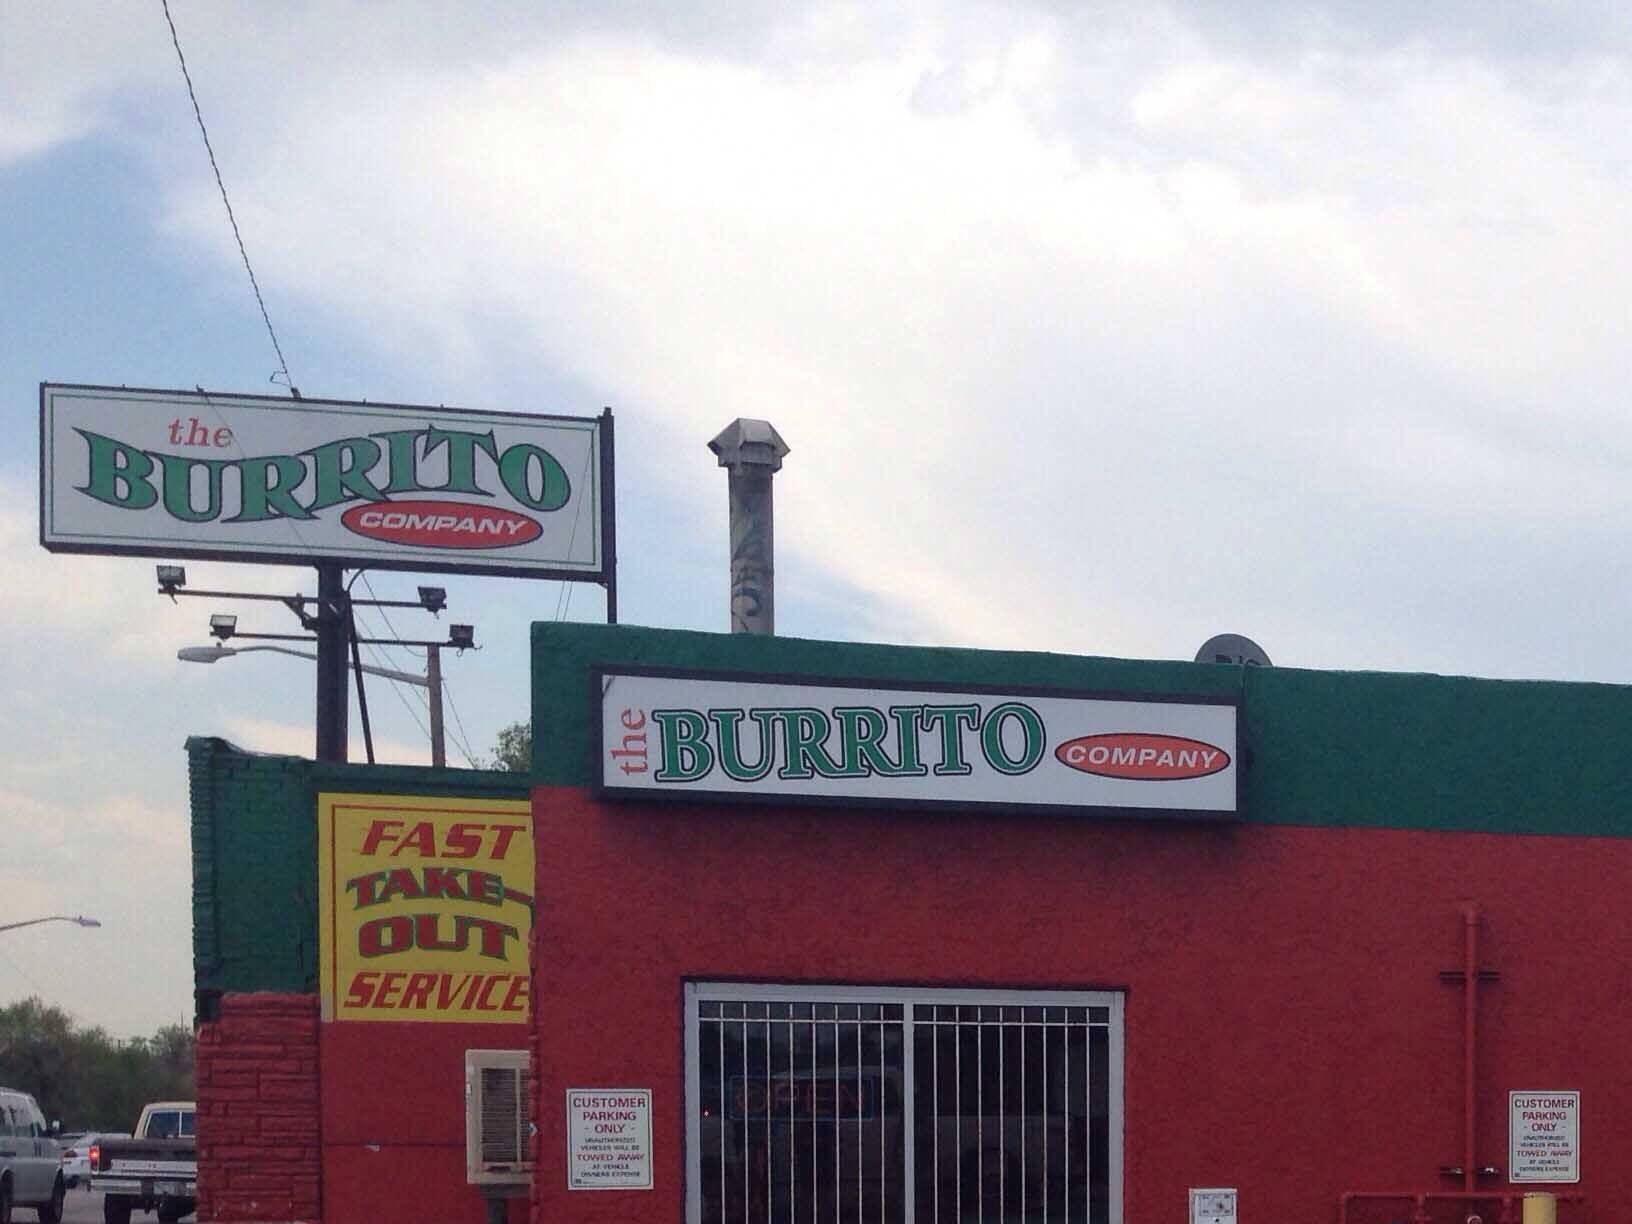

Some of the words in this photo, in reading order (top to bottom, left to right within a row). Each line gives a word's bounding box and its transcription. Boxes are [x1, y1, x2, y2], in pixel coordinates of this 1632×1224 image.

[167, 417, 233, 448] the
[72, 424, 571, 523] BURRITO
[359, 511, 527, 536] COMPANY
[610, 707, 648, 777] the
[651, 703, 1046, 782] BURRITO
[1064, 744, 1220, 771] COMPANY
[359, 819, 527, 860] FAST
[358, 912, 519, 962] OUT
[344, 970, 529, 1011] SERVICE
[573, 1097, 646, 1108] CUSTOMER
[583, 1111, 637, 1121] PARKING
[1514, 1099, 1575, 1108] CUSTOMER
[1522, 1111, 1567, 1120] PARKING
[594, 1123, 626, 1134] ONLY
[1531, 1123, 1558, 1132] ONLY
